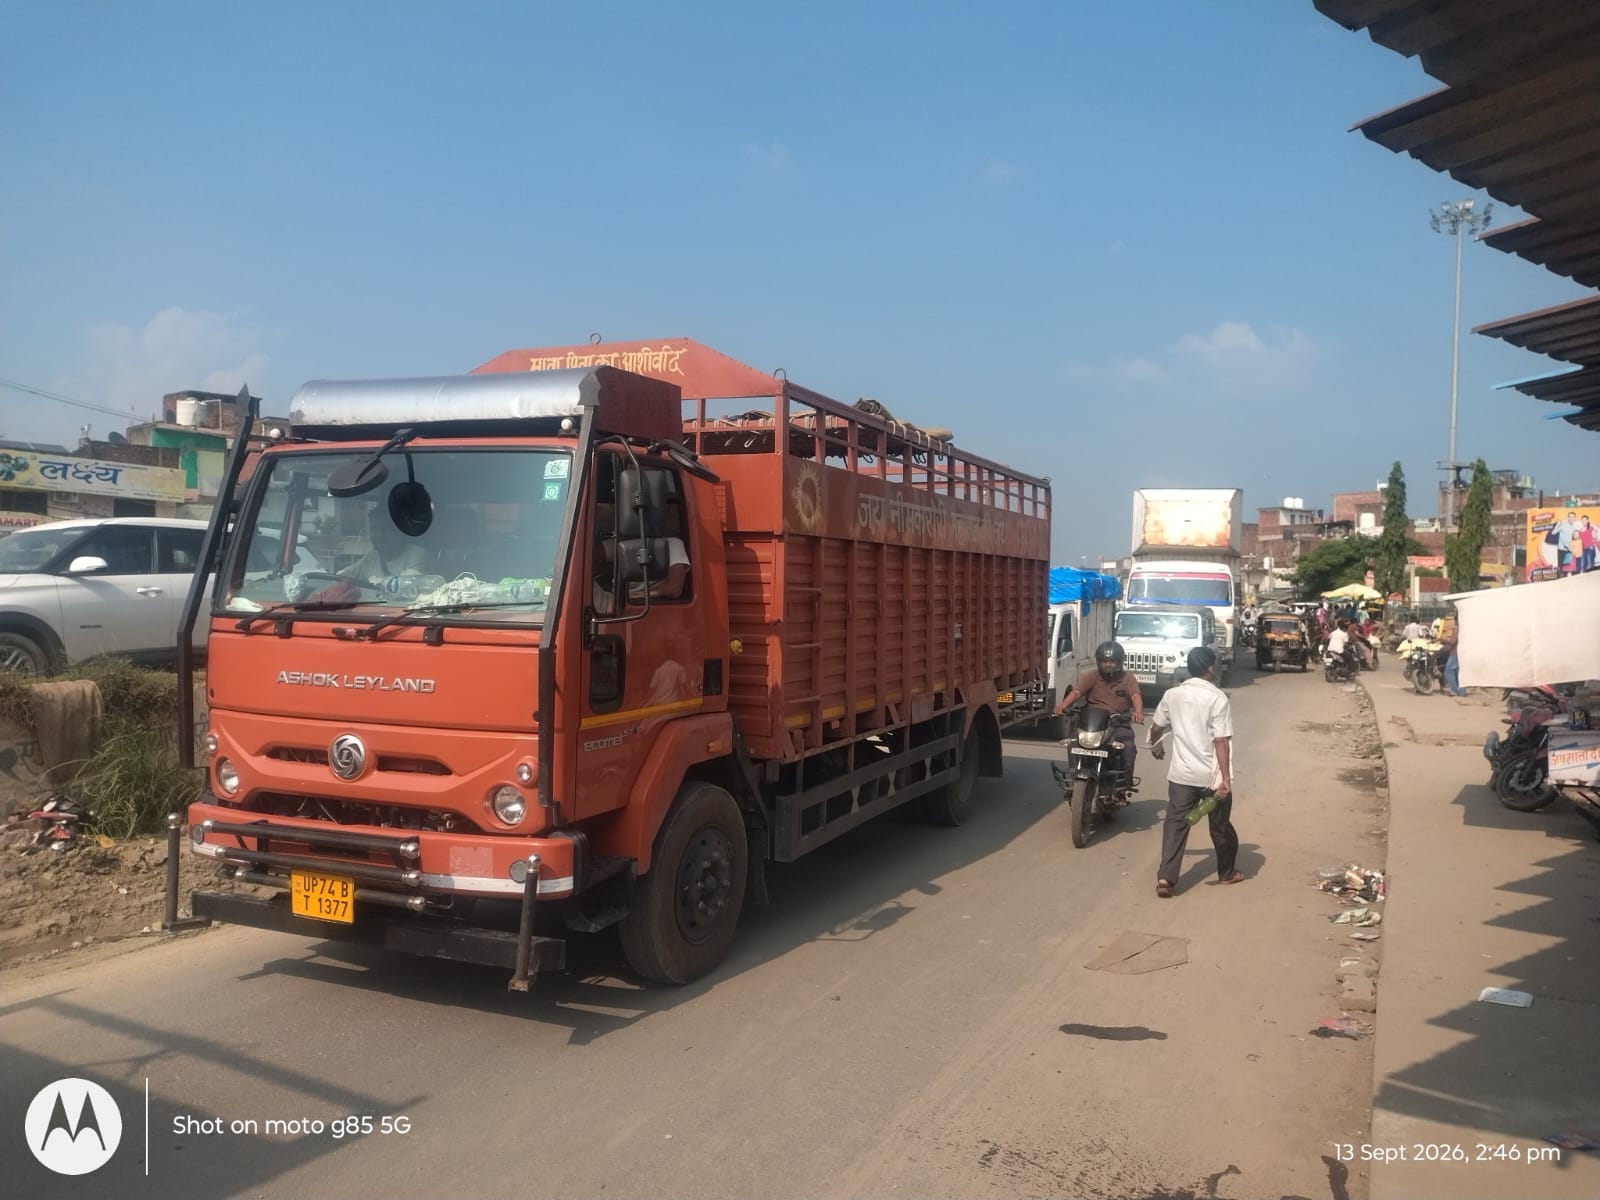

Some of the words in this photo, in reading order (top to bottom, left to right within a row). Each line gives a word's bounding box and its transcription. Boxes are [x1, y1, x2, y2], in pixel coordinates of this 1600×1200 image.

[277, 671, 339, 688] ASHOK
[343, 675, 435, 693] LEYLAND
[303, 875, 336, 896] UP74
[341, 880, 348, 898] B
[303, 894, 310, 911] T
[317, 897, 349, 917] 1377
